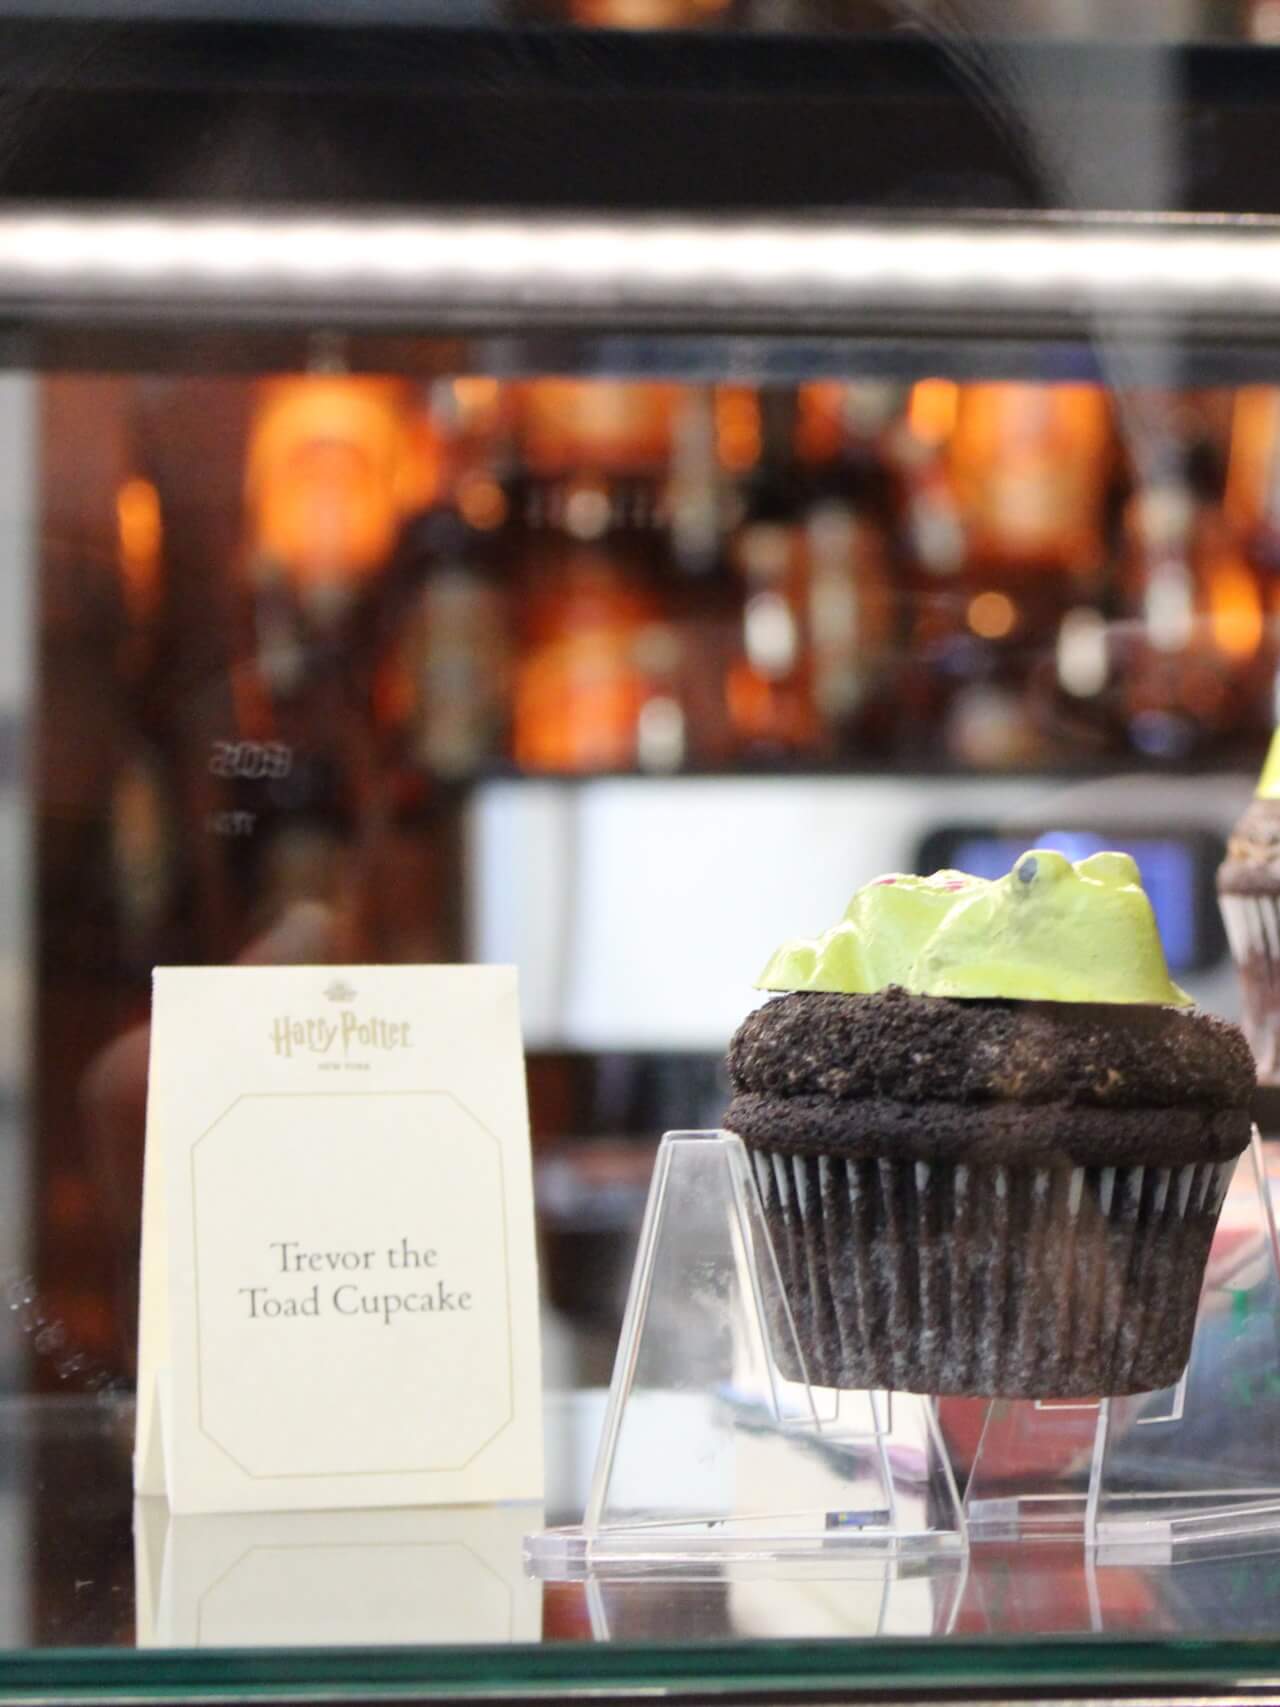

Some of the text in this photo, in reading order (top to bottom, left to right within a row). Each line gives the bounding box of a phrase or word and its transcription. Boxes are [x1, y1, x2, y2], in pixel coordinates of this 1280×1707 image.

[269, 1009, 414, 1058] Harry Potter
[269, 1236, 438, 1273] Trevor the
[238, 1280, 473, 1326] Toad Cupcake
